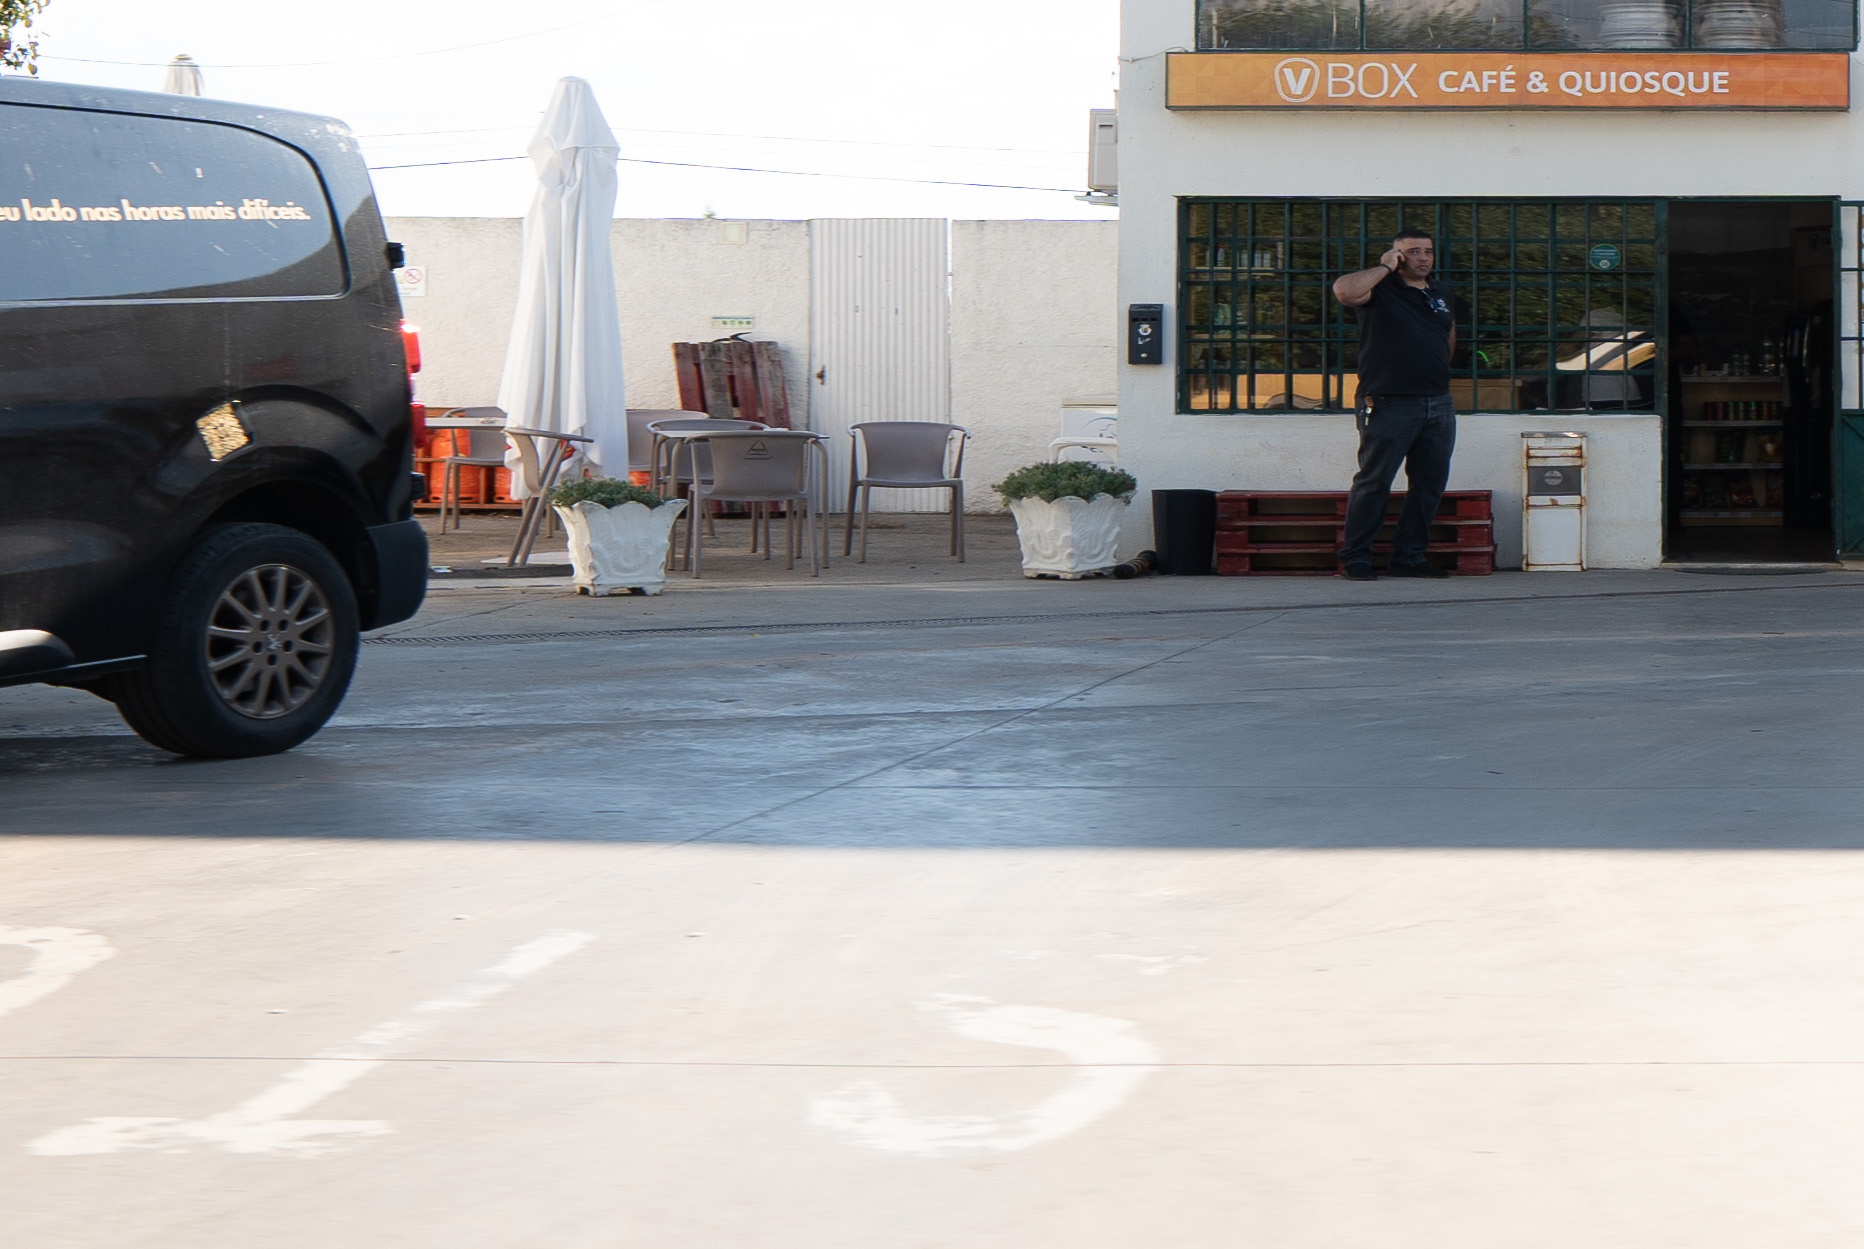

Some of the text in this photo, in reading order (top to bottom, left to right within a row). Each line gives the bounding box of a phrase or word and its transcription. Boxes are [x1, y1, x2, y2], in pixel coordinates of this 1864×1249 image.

[1326, 63, 1418, 98] BOX
[1437, 63, 1516, 94] CAFÉ
[1526, 71, 1550, 94] &
[1559, 70, 1730, 98] QUIOSQUE
[21, 198, 78, 222] lado
[79, 206, 122, 222] nas
[121, 198, 186, 221] horas
[187, 200, 237, 220] mais
